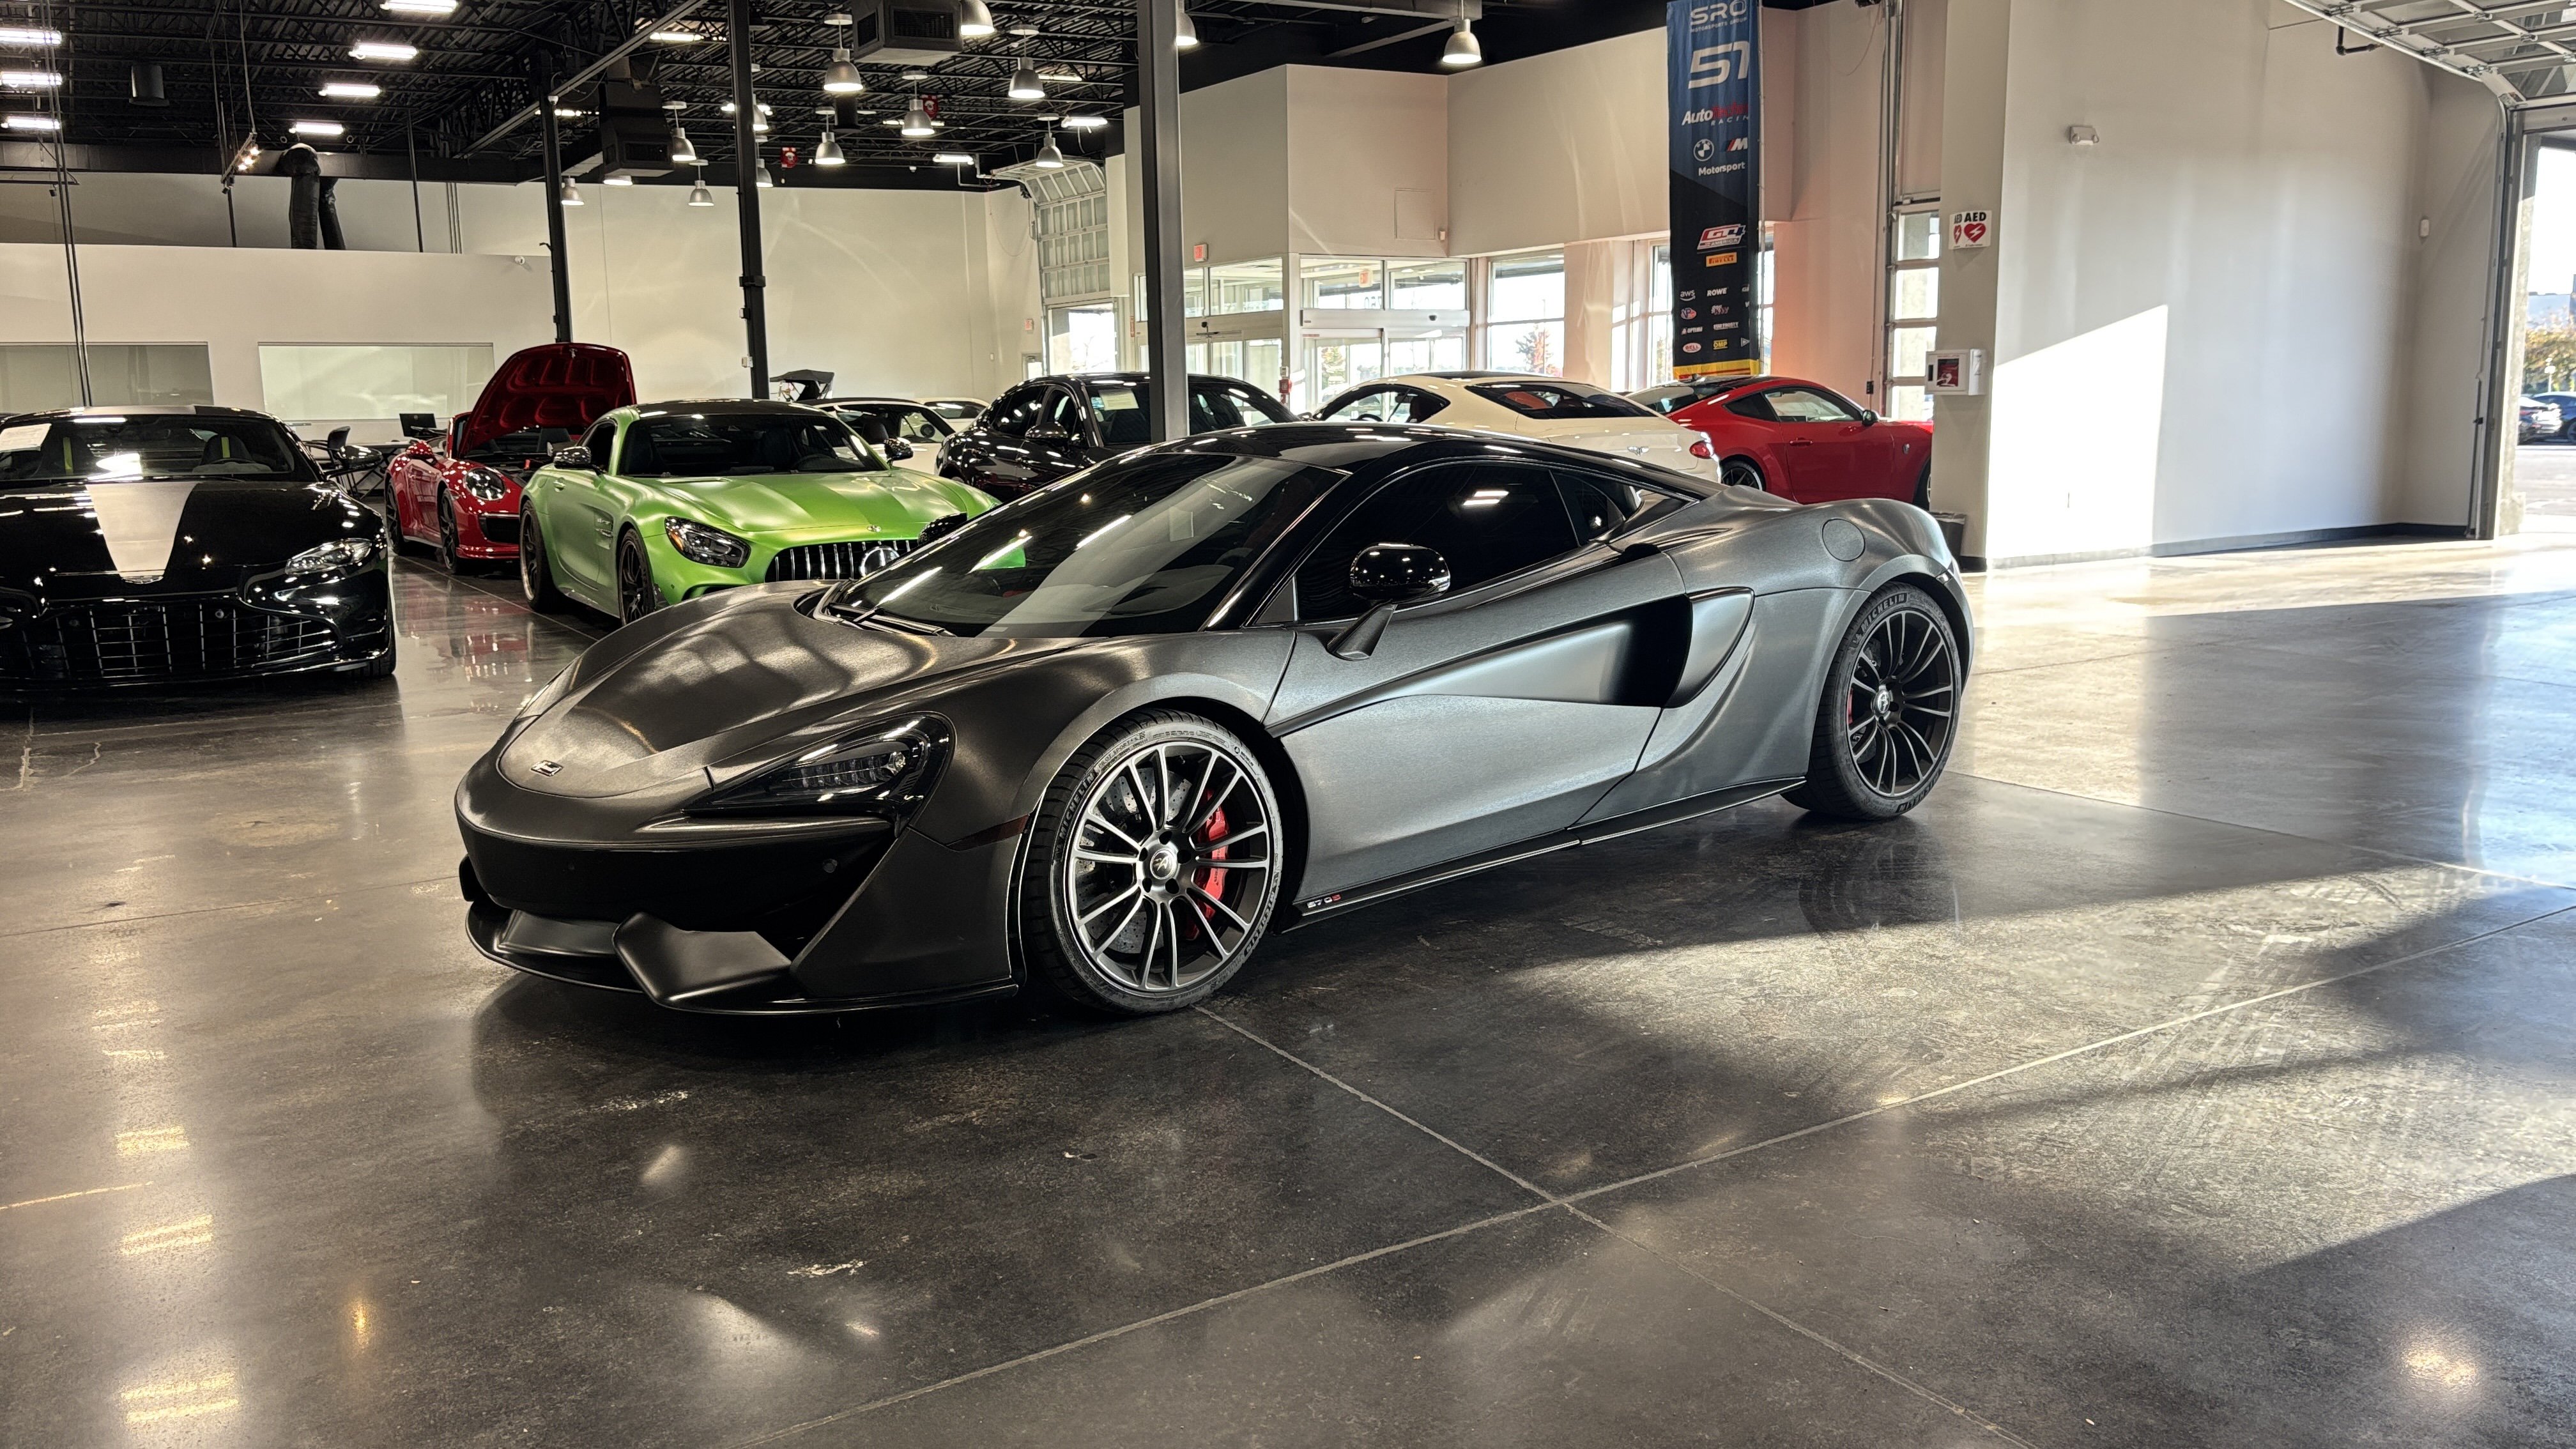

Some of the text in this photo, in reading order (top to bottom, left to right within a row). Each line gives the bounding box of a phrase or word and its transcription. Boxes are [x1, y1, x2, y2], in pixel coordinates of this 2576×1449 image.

[1690, 0, 1747, 25] SRO
[1689, 41, 1750, 89] 51
[1698, 162, 1745, 176] Motorsport
[1964, 211, 1987, 222] AED
[1706, 288, 1728, 296] ROWE
[1860, 594, 1905, 632] MICHELIN
[1058, 770, 1096, 839] MICHELIN
[1307, 894, 1341, 908] 570S
